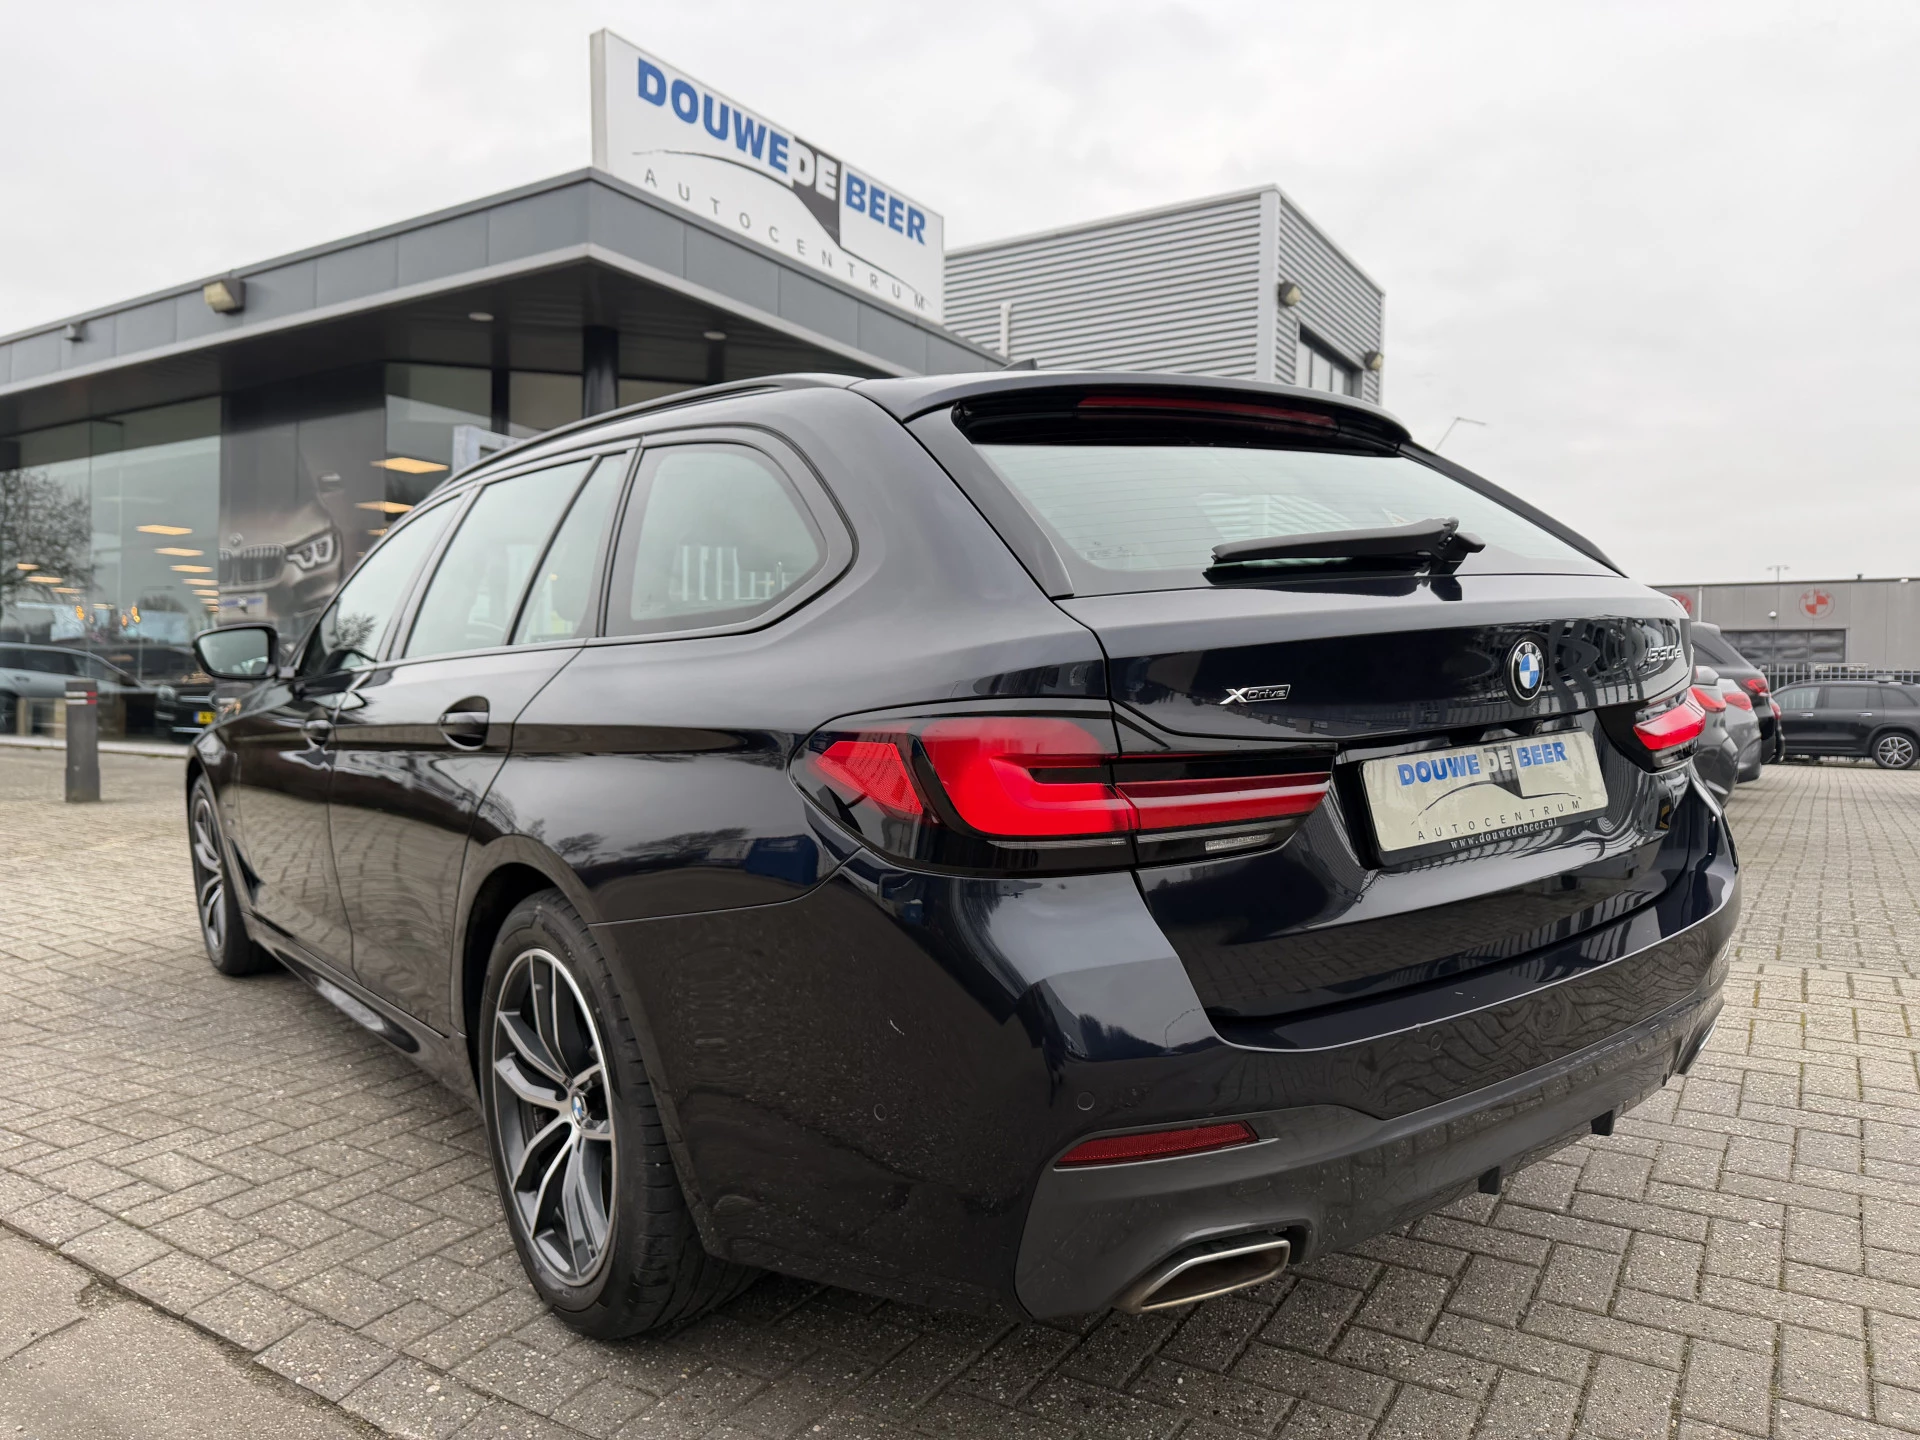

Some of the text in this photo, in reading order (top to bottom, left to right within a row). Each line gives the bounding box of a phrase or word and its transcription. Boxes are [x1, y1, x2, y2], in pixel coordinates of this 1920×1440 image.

[638, 57, 926, 246] DOUWE DE BEER
[645, 168, 926, 311] AUTOCENTRUM
[1515, 643, 1542, 662] BMW
[1397, 742, 1568, 786] DOUWE DE BEER
[1417, 801, 1580, 840] AUTOCENTRUM
[1450, 818, 1557, 849] www.douwedebeer.nl
